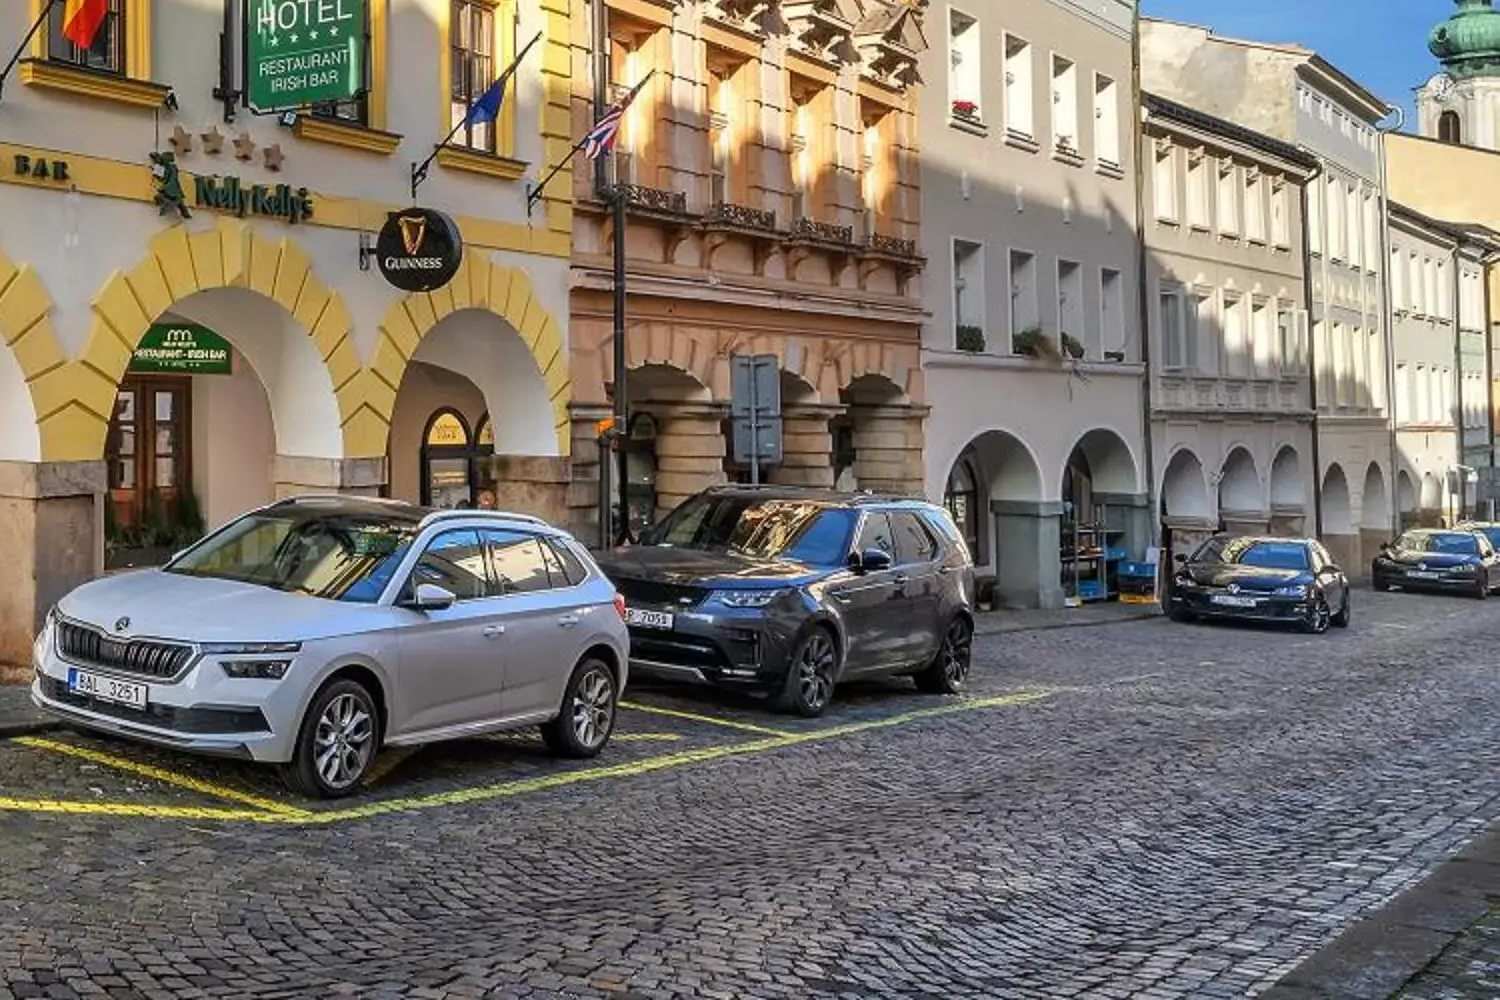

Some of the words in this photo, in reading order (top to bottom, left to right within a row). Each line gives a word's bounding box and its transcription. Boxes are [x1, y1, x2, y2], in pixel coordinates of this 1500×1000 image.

[259, 49, 349, 77] RESTAURANT
[271, 74, 307, 93] IRISH
[309, 70, 339, 88] BAR
[14, 154, 70, 180] BAR
[195, 175, 251, 218] Nelly
[385, 256, 443, 270] GUINNESS
[109, 681, 139, 702] 3251
